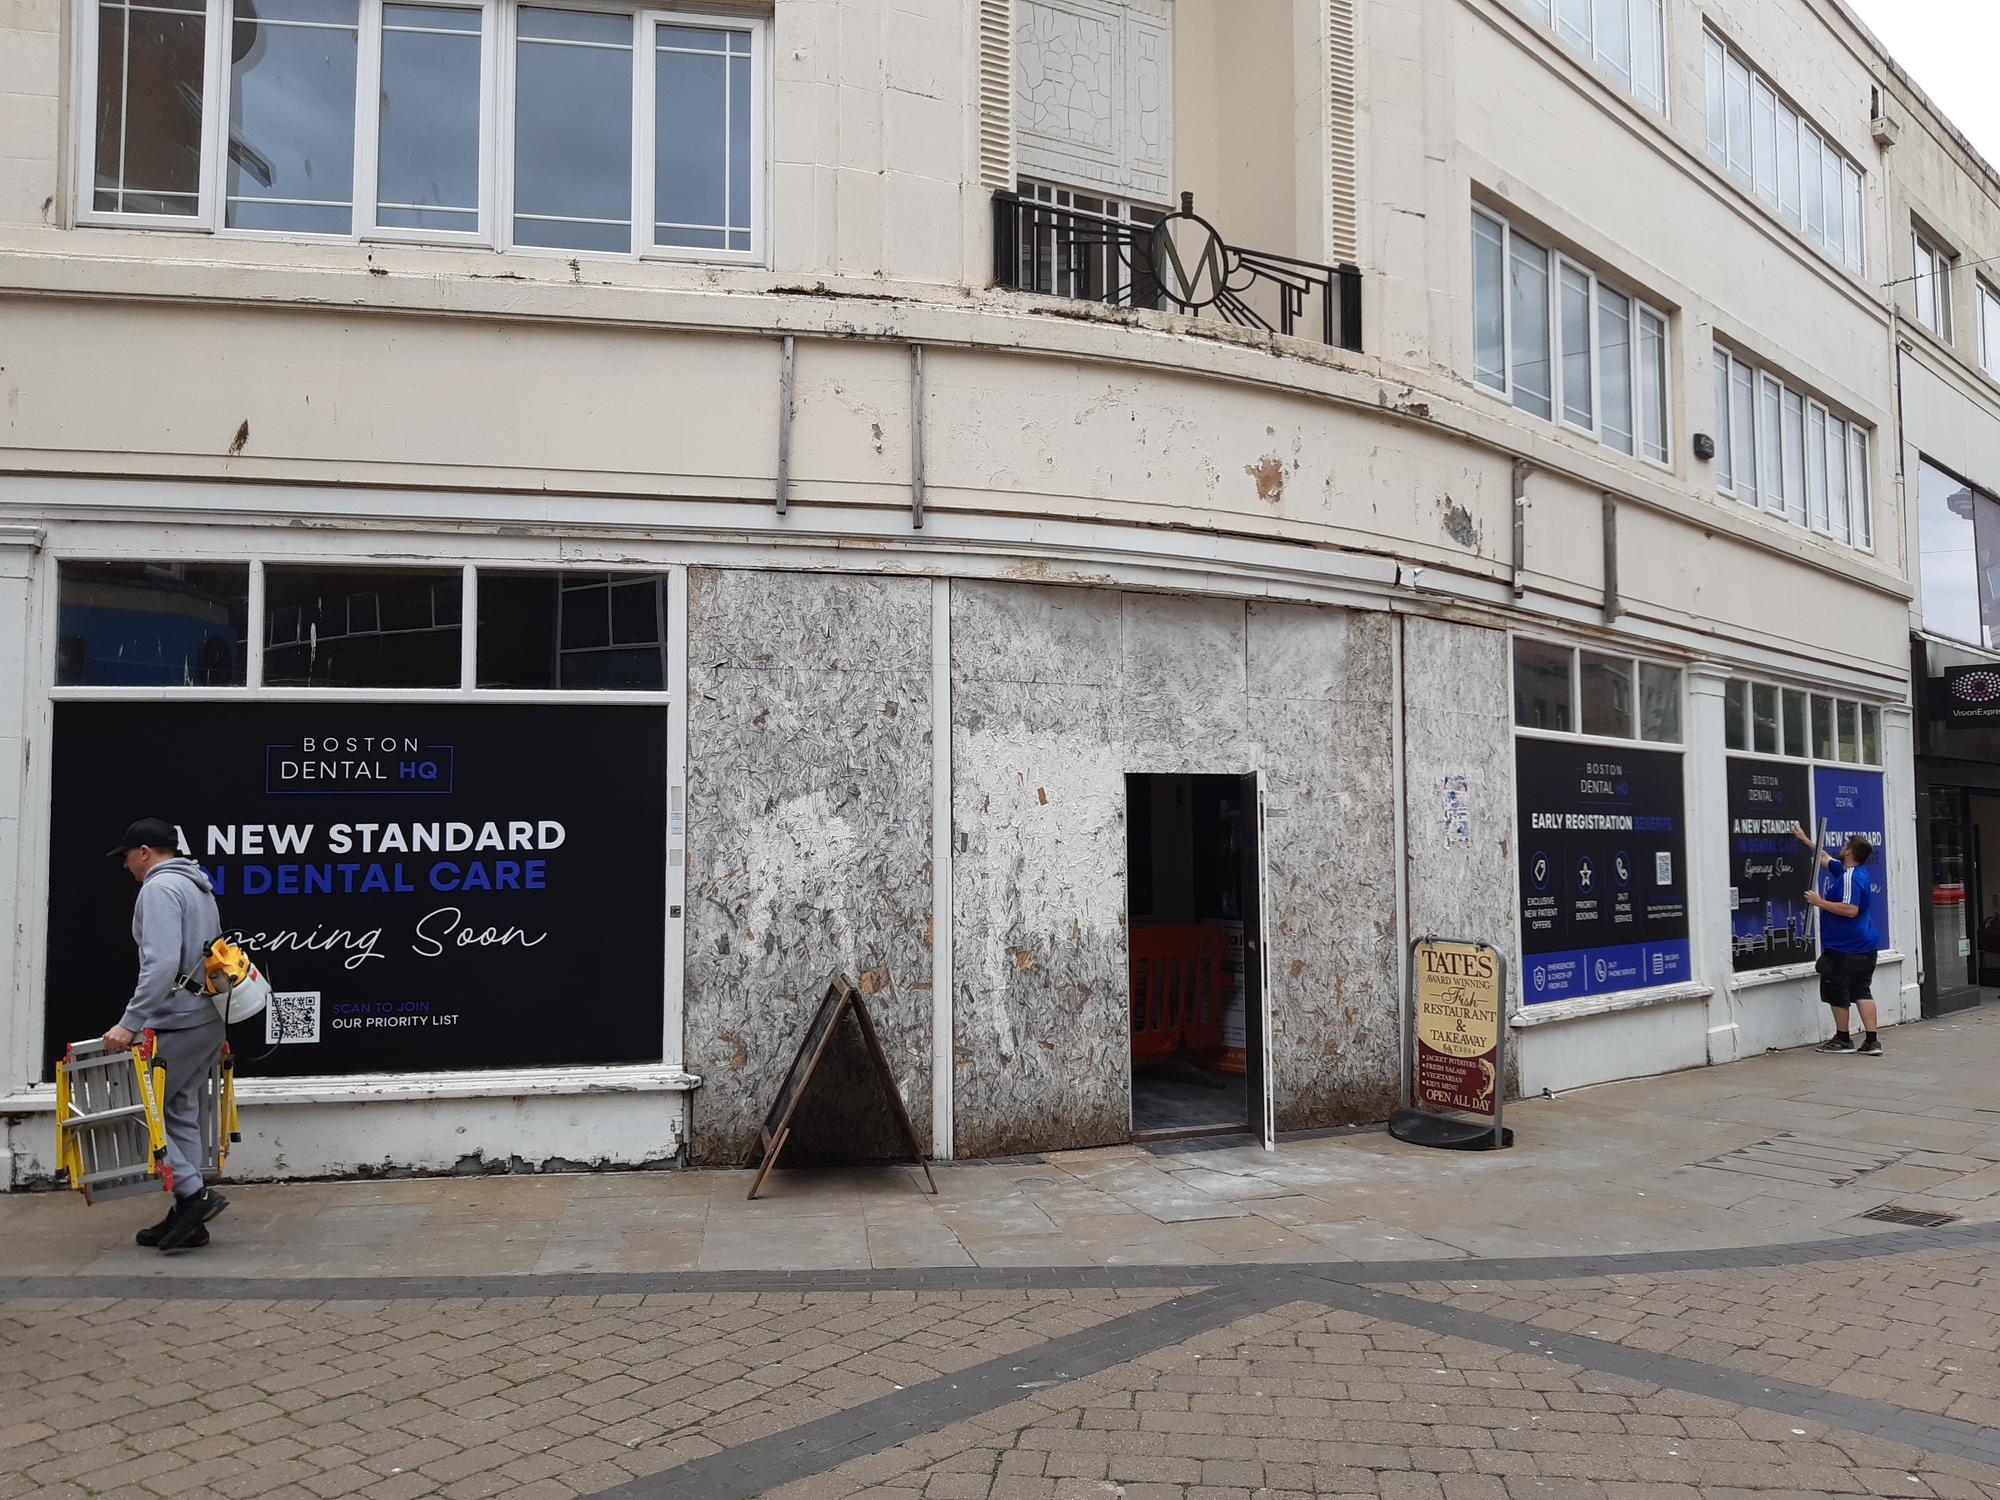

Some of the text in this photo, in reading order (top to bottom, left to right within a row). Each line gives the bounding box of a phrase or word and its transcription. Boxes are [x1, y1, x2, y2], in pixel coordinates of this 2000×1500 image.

[303, 737, 418, 752] BOSTON
[281, 761, 438, 780] DENTAL HQ
[1586, 762, 1623, 776] BOSTON
[1580, 779, 1615, 794] DENTAL
[1531, 812, 1564, 829] EARLY
[1565, 813, 1633, 830] REGISTRATION
[1733, 818, 1741, 834] A
[1741, 818, 1761, 834] NEW
[207, 824, 314, 855] NEW
[328, 820, 566, 855] STANDARD
[1825, 831, 1843, 847] NEW
[200, 859, 546, 895] N DENTAL CARE
[411, 906, 548, 957] Soon
[1422, 950, 1493, 979] TATES
[1426, 975, 1490, 989] AWARD WINNING
[1440, 986, 1478, 1008] Fish
[332, 1001, 429, 1014] SCAN TO JOIN
[1423, 1003, 1497, 1022] RESTAURANT
[332, 1014, 460, 1029] OUR PRIORITY LIST
[1456, 1018, 1466, 1033] &
[1430, 1029, 1487, 1048] TAKEAWAY
[1426, 1054, 1477, 1069] JACKET POTATOES
[1426, 1063, 1467, 1075] FRESH SALADS
[1426, 1072, 1463, 1083] VEGETARIAN
[1441, 1083, 1459, 1091] MENU
[1426, 1089, 1491, 1111] OPEN ALL DAY
